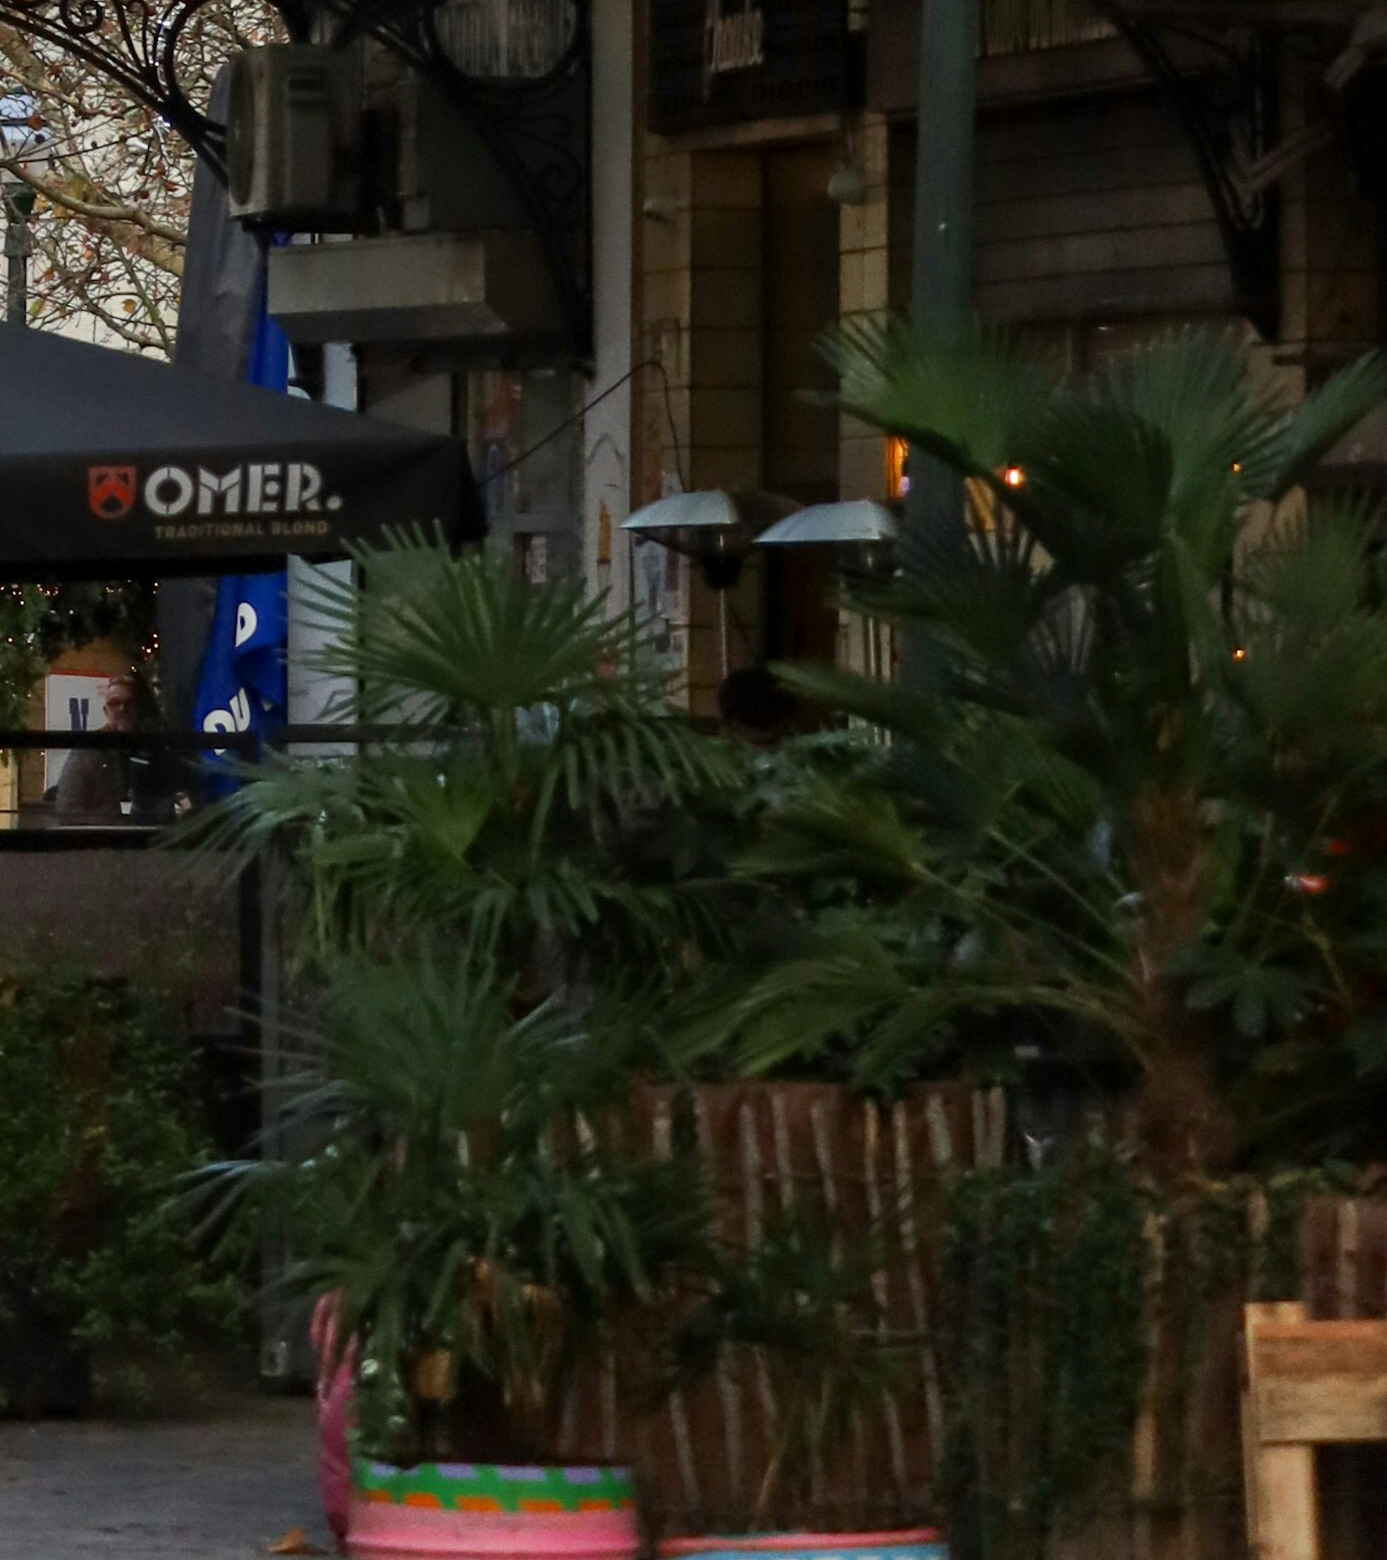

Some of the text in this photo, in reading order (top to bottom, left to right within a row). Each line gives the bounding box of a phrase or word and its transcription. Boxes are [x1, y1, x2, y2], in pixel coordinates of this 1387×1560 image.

[144, 462, 343, 515] OMER.
[155, 520, 329, 540] TRADITIONAL BLOND
